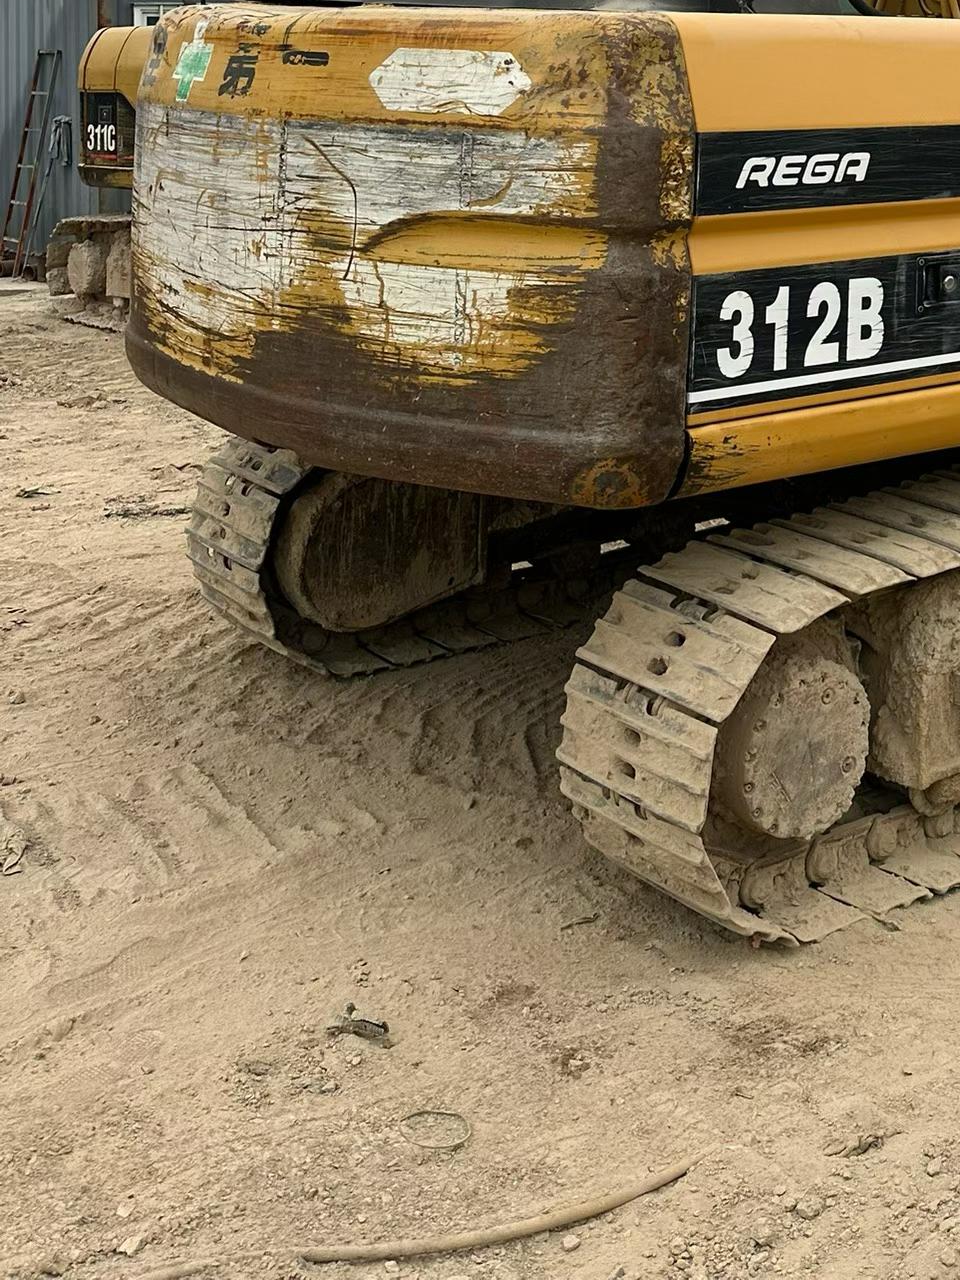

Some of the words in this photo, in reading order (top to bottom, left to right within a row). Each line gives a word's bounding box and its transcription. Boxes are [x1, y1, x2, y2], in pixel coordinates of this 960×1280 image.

[87, 124, 116, 152] 311C
[735, 151, 871, 190] REGA
[717, 276, 886, 380] 312B
